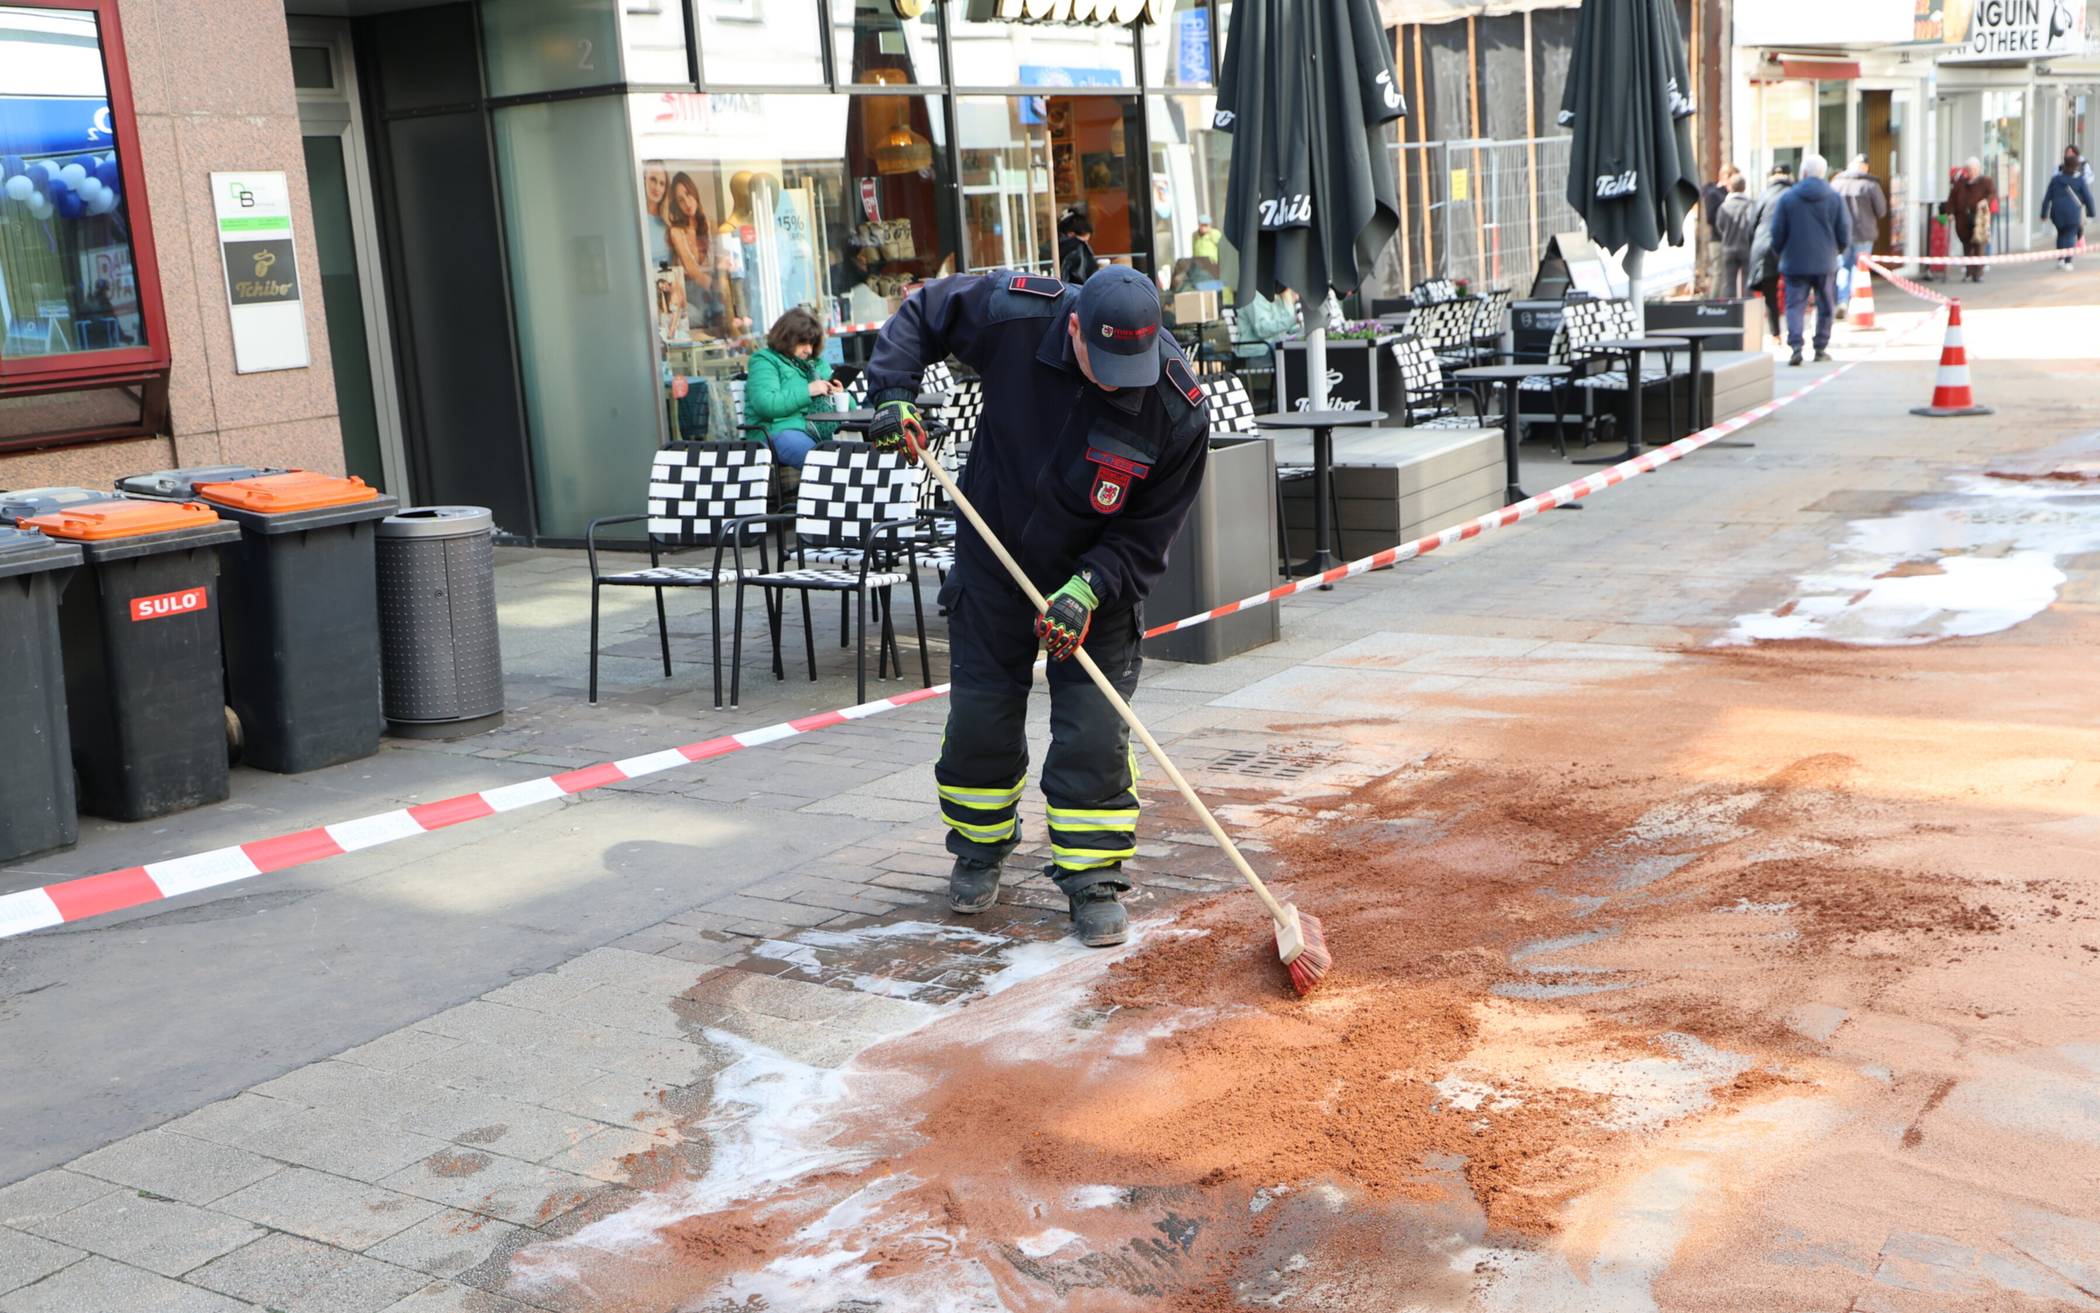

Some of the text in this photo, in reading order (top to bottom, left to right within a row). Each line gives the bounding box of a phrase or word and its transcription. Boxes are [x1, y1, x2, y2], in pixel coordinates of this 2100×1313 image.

[577, 38, 594, 71] 2
[236, 280, 293, 298] Tchibo
[138, 593, 197, 617] SULO
